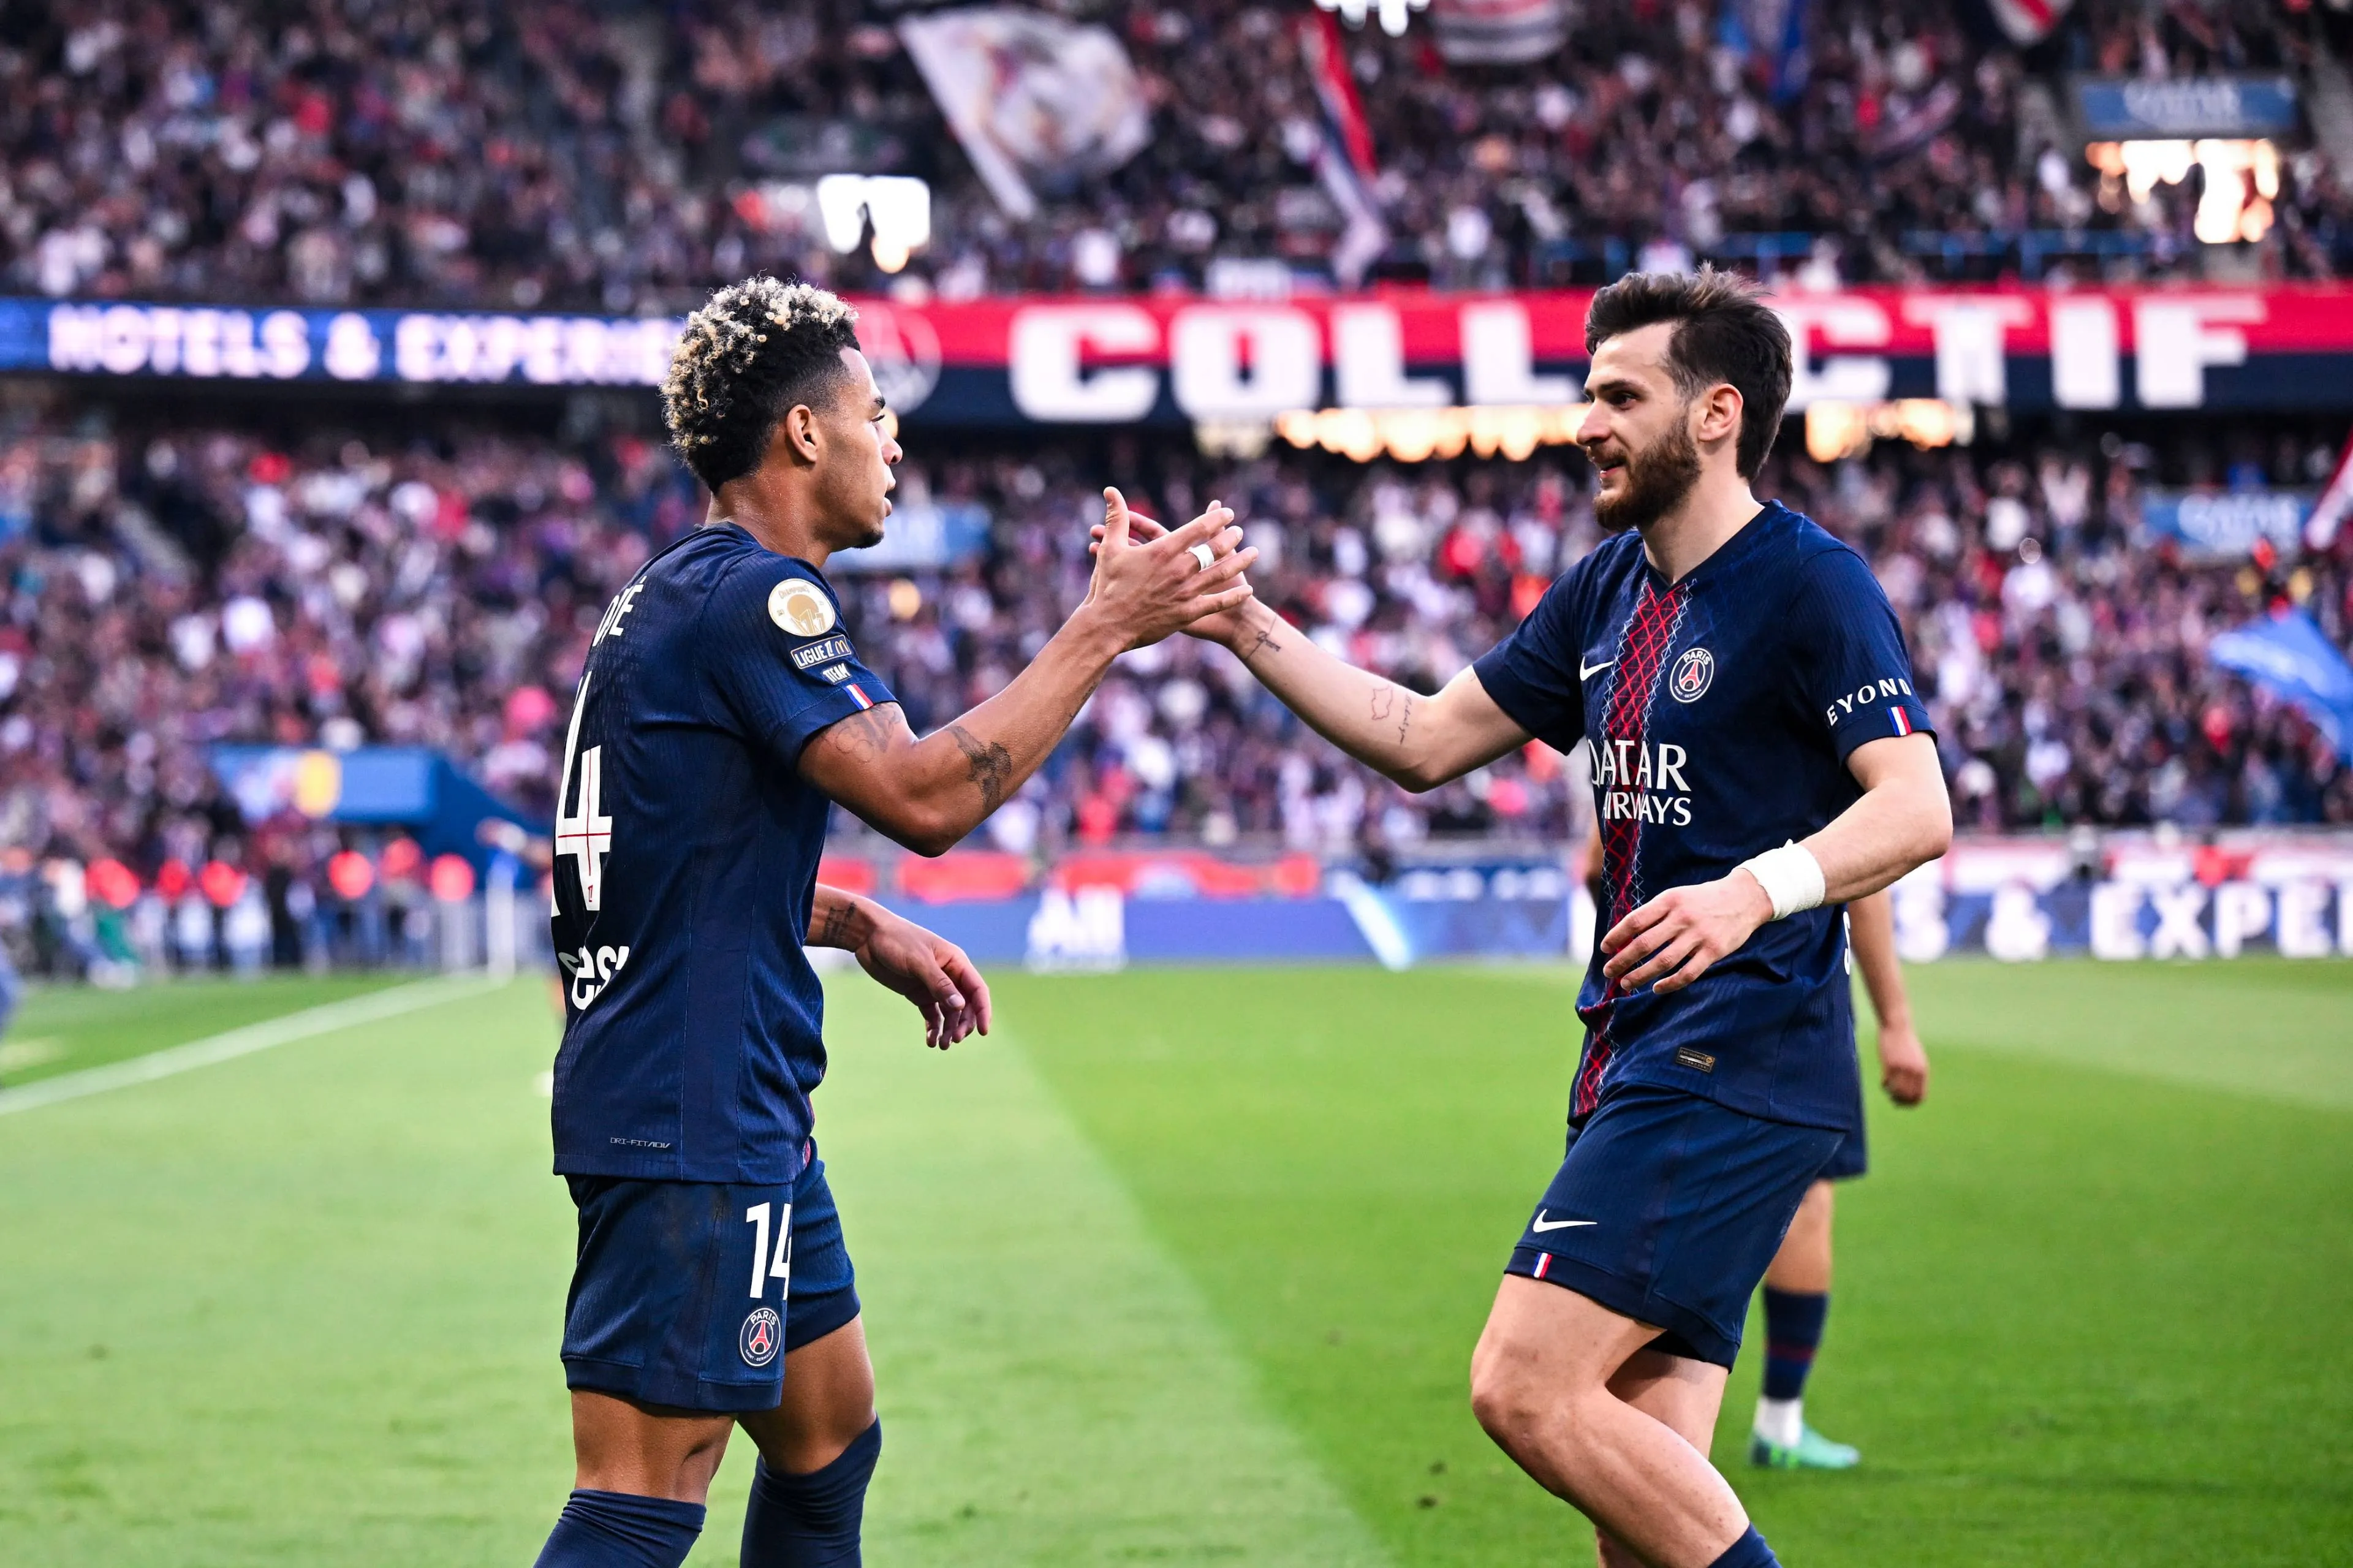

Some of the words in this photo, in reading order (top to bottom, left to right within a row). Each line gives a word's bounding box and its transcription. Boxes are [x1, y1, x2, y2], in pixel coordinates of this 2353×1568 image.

[48, 304, 310, 379] HOTELS
[324, 310, 381, 381] &
[1008, 294, 2268, 423] COLLCTIF
[794, 645, 828, 667] LIGUE
[1683, 650, 1711, 665] PARIS
[1826, 678, 1912, 727] EYOND
[551, 671, 613, 918] 4
[1984, 884, 2052, 964] &
[2090, 881, 2353, 960] EXPE
[746, 1202, 791, 1301] 14
[750, 1310, 776, 1325] PARIS
